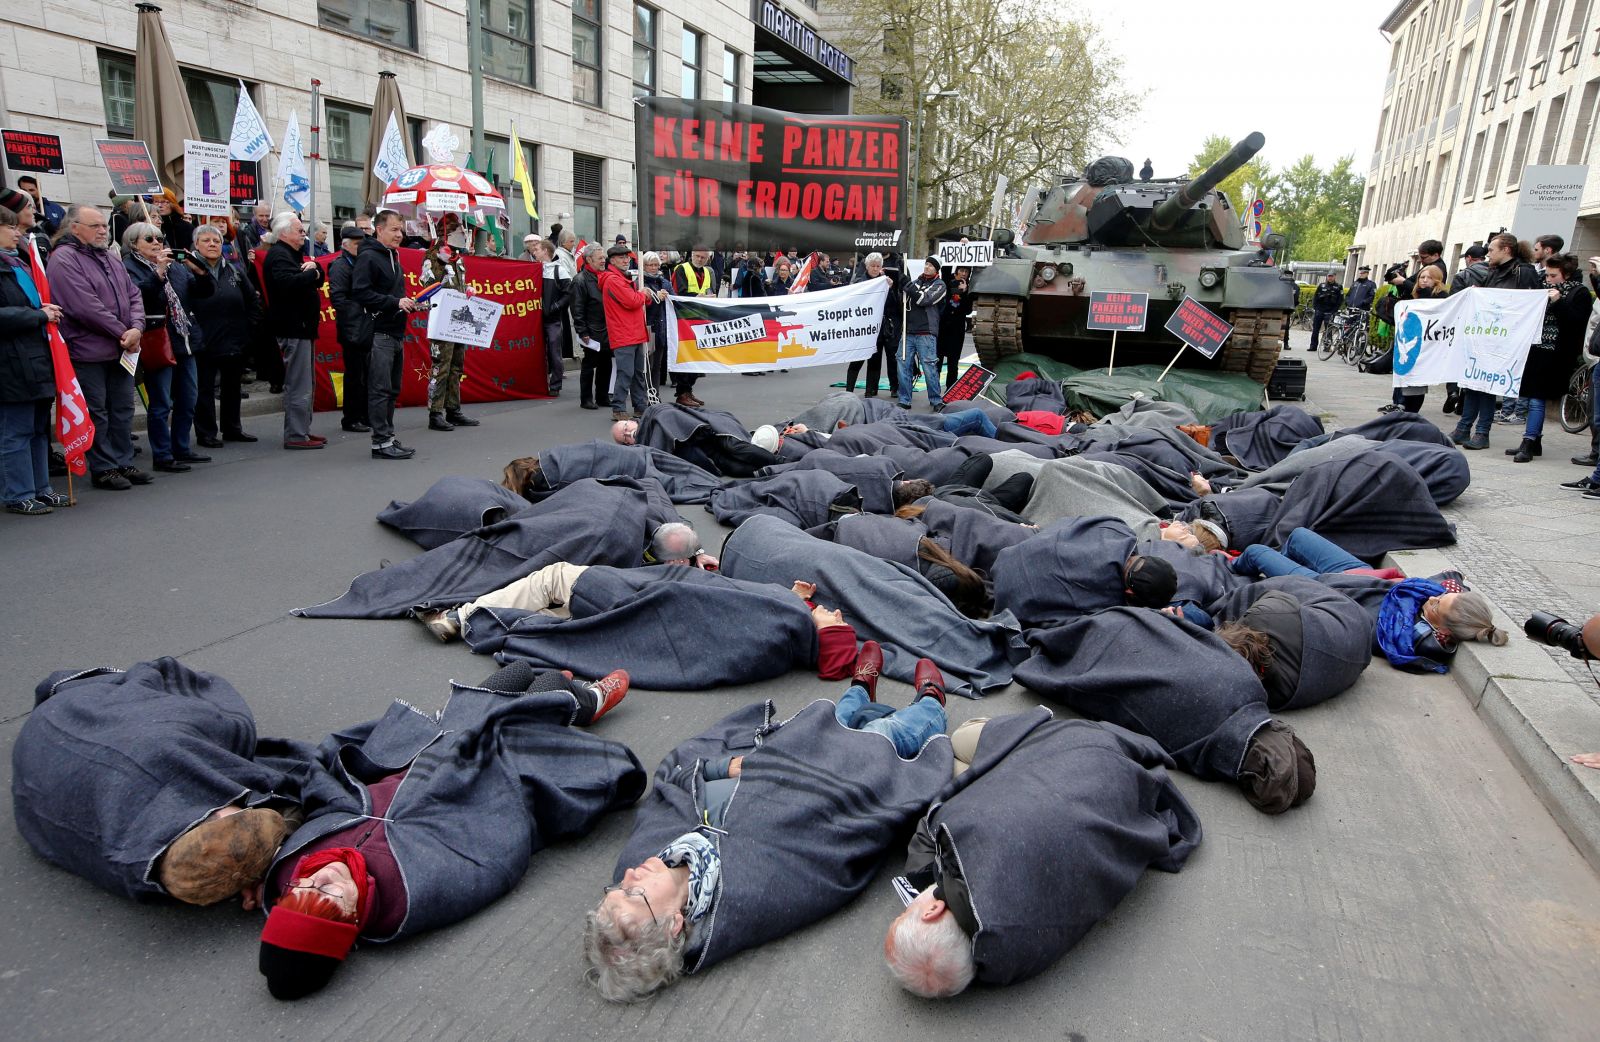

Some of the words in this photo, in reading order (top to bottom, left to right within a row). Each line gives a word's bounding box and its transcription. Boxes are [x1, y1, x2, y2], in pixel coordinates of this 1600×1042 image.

[763, 2, 815, 56] MARITIM
[820, 39, 849, 80] HOTEL
[653, 116, 765, 163] KEINE
[782, 125, 899, 170] PANZER
[654, 169, 720, 217] FÜR
[736, 180, 898, 222] ERDOGAN!
[854, 229, 903, 249] campact!
[940, 243, 993, 263] ABRÜSTEN.
[703, 316, 753, 336] AKTION
[817, 307, 853, 322] Stoppt
[854, 306, 874, 317] den
[698, 321, 766, 349] AUFSCHREI
[1464, 356, 1507, 391] Junepa
